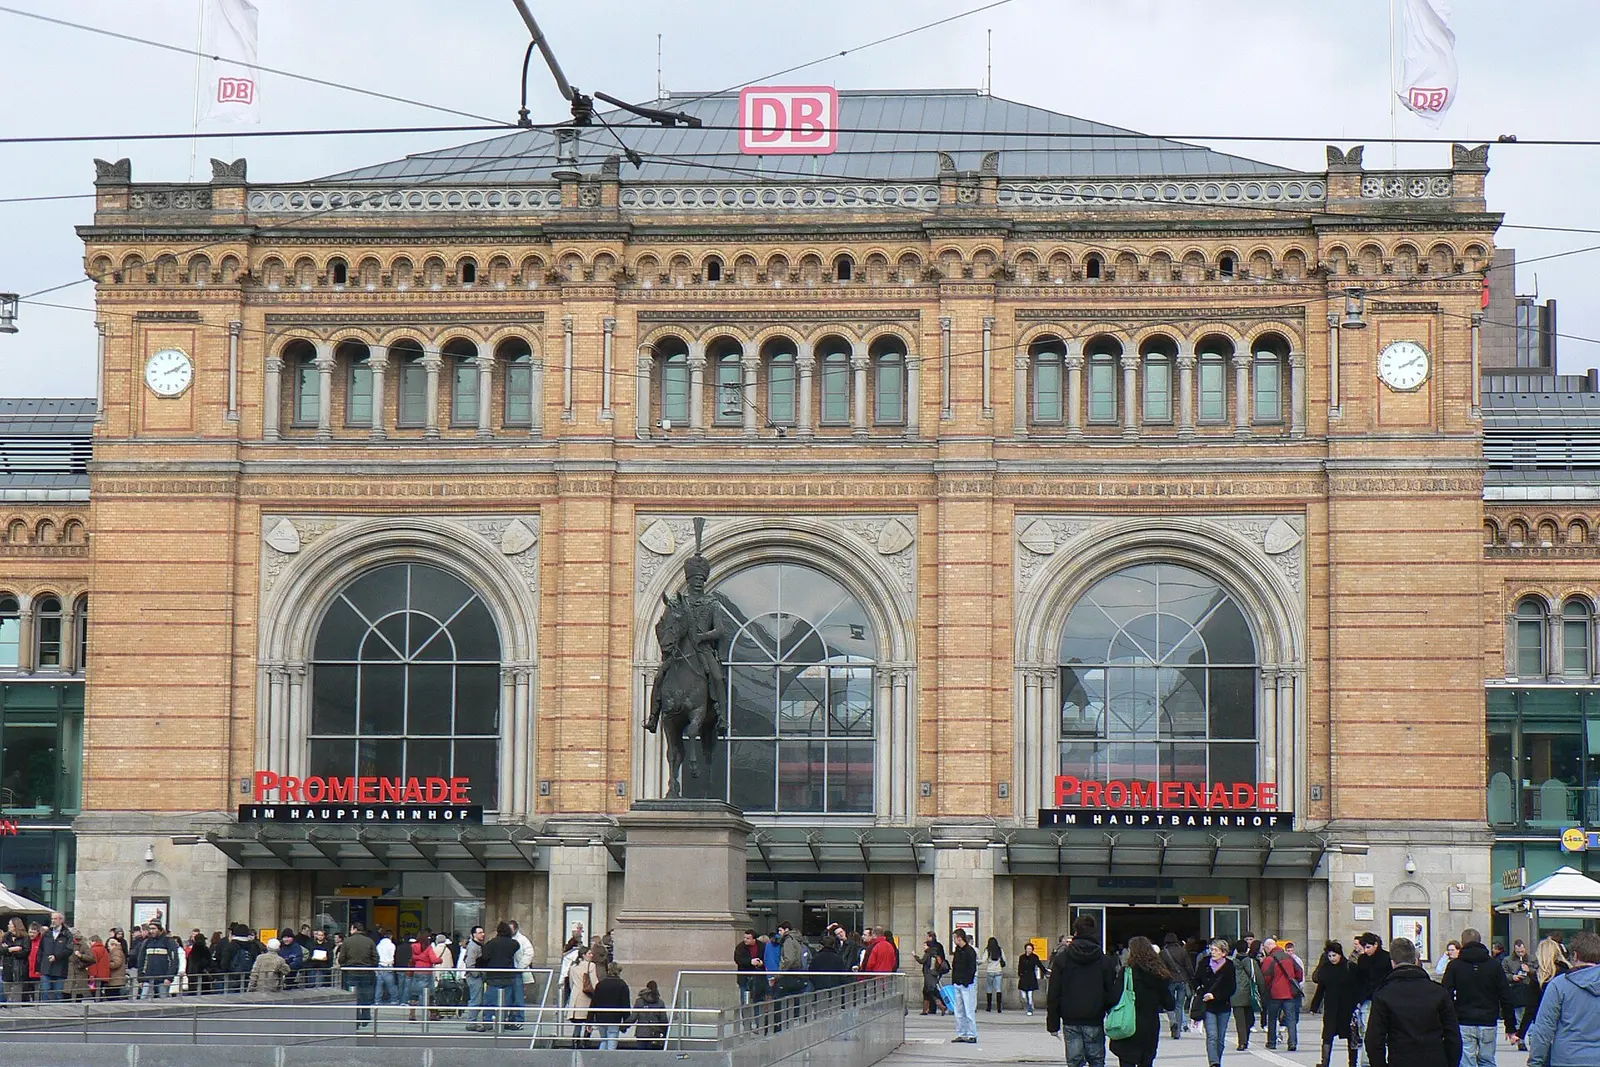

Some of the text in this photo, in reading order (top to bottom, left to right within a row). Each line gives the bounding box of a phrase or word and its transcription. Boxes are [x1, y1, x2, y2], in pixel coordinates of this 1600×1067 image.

[222, 82, 249, 99] DB
[1413, 92, 1443, 110] DB
[751, 97, 825, 143] DB
[254, 770, 470, 804] PROMENADE
[1054, 775, 1278, 810] PROMENADE
[252, 809, 468, 820] IM HAUPTBAHNHOF
[1053, 814, 1278, 826] IM HAUPTBAHNHOF
